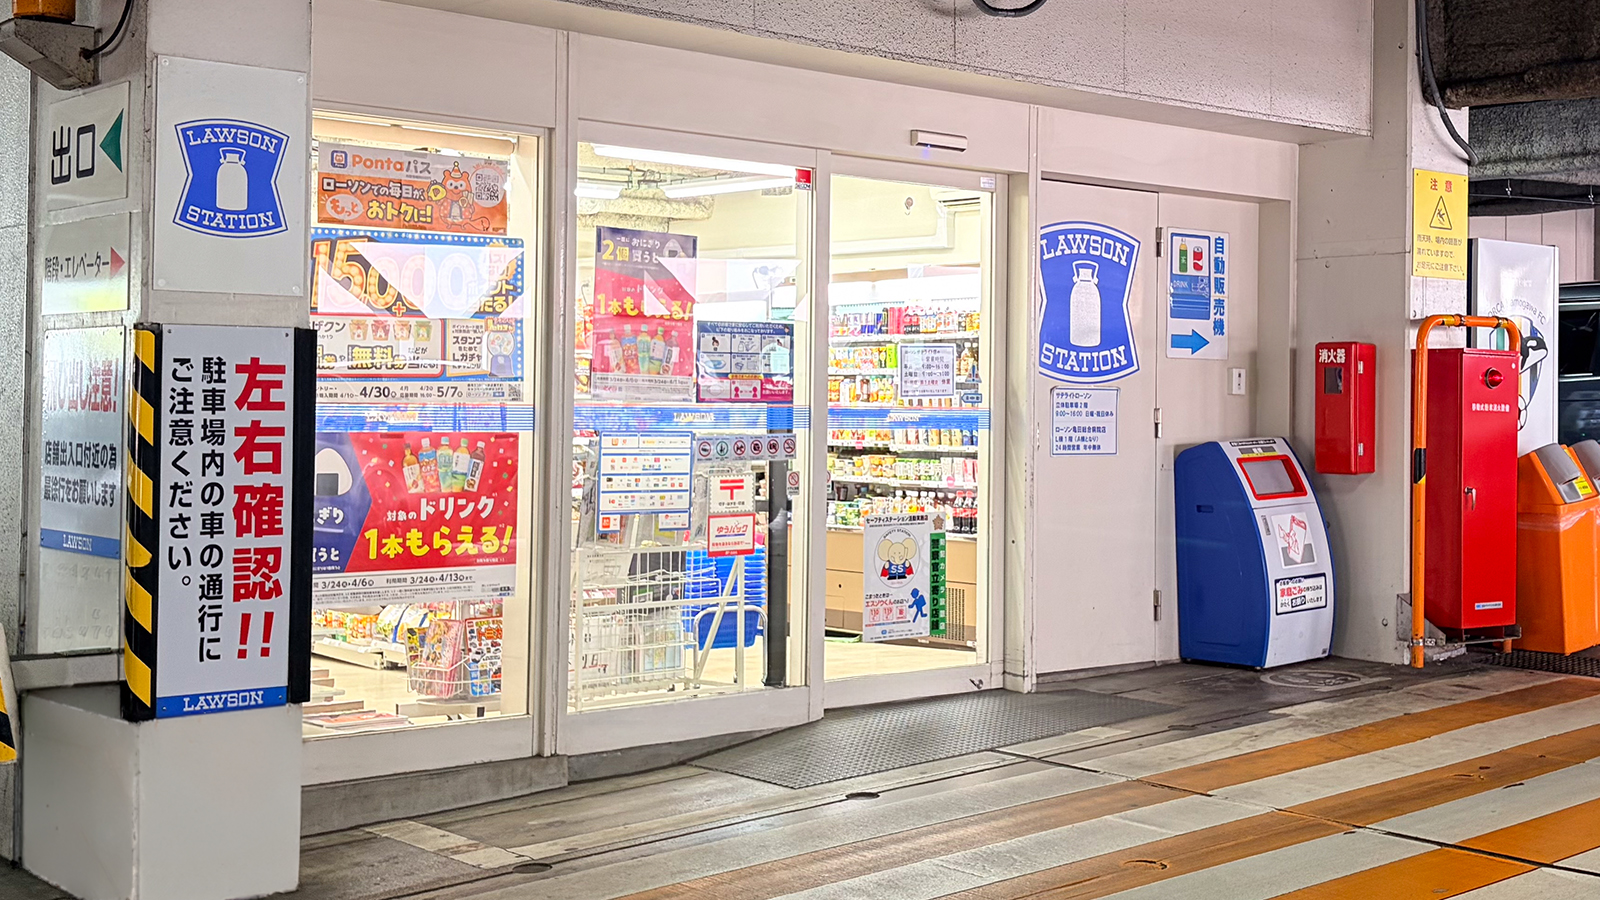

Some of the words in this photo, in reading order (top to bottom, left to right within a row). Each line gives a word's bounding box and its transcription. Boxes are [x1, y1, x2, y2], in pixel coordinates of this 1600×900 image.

[187, 127, 280, 153] LAWSON
[51, 123, 96, 185] 出口
[322, 177, 426, 201] ローソンでの毎日が、
[1430, 178, 1453, 193] 注意
[186, 205, 276, 230] STATION
[329, 198, 359, 216] もっと
[602, 239, 630, 262] 2個
[632, 249, 660, 264] 買うと
[631, 238, 661, 248] おにぎり
[1041, 234, 1130, 266] LAWSON
[45, 251, 110, 283] 階段・エレベーター
[1173, 280, 1189, 289] DRINK
[1213, 236, 1225, 336] 自動販売機
[1505, 298, 1538, 315] amogawa
[1537, 311, 1546, 325] FC
[1041, 342, 1128, 372] STATION
[1318, 348, 1346, 363] 消火器
[673, 413, 715, 422] LAWSON
[45, 439, 117, 470] 店舗出入口付近の為
[167, 357, 195, 586] ご注意ください。
[44, 475, 117, 507] 最徐行をお願いします
[198, 356, 227, 662] 駐車場内の車の通行に
[232, 356, 286, 659] 左右確認!!
[386, 496, 494, 521] 対象のドリンク
[716, 522, 748, 534] ゆうパック
[897, 528, 911, 537] STATION
[62, 534, 92, 551] LAWSON
[313, 547, 340, 562] うと
[364, 525, 513, 560] 1本もらえる!
[891, 564, 904, 573] SS
[182, 690, 264, 712] LAWSON
